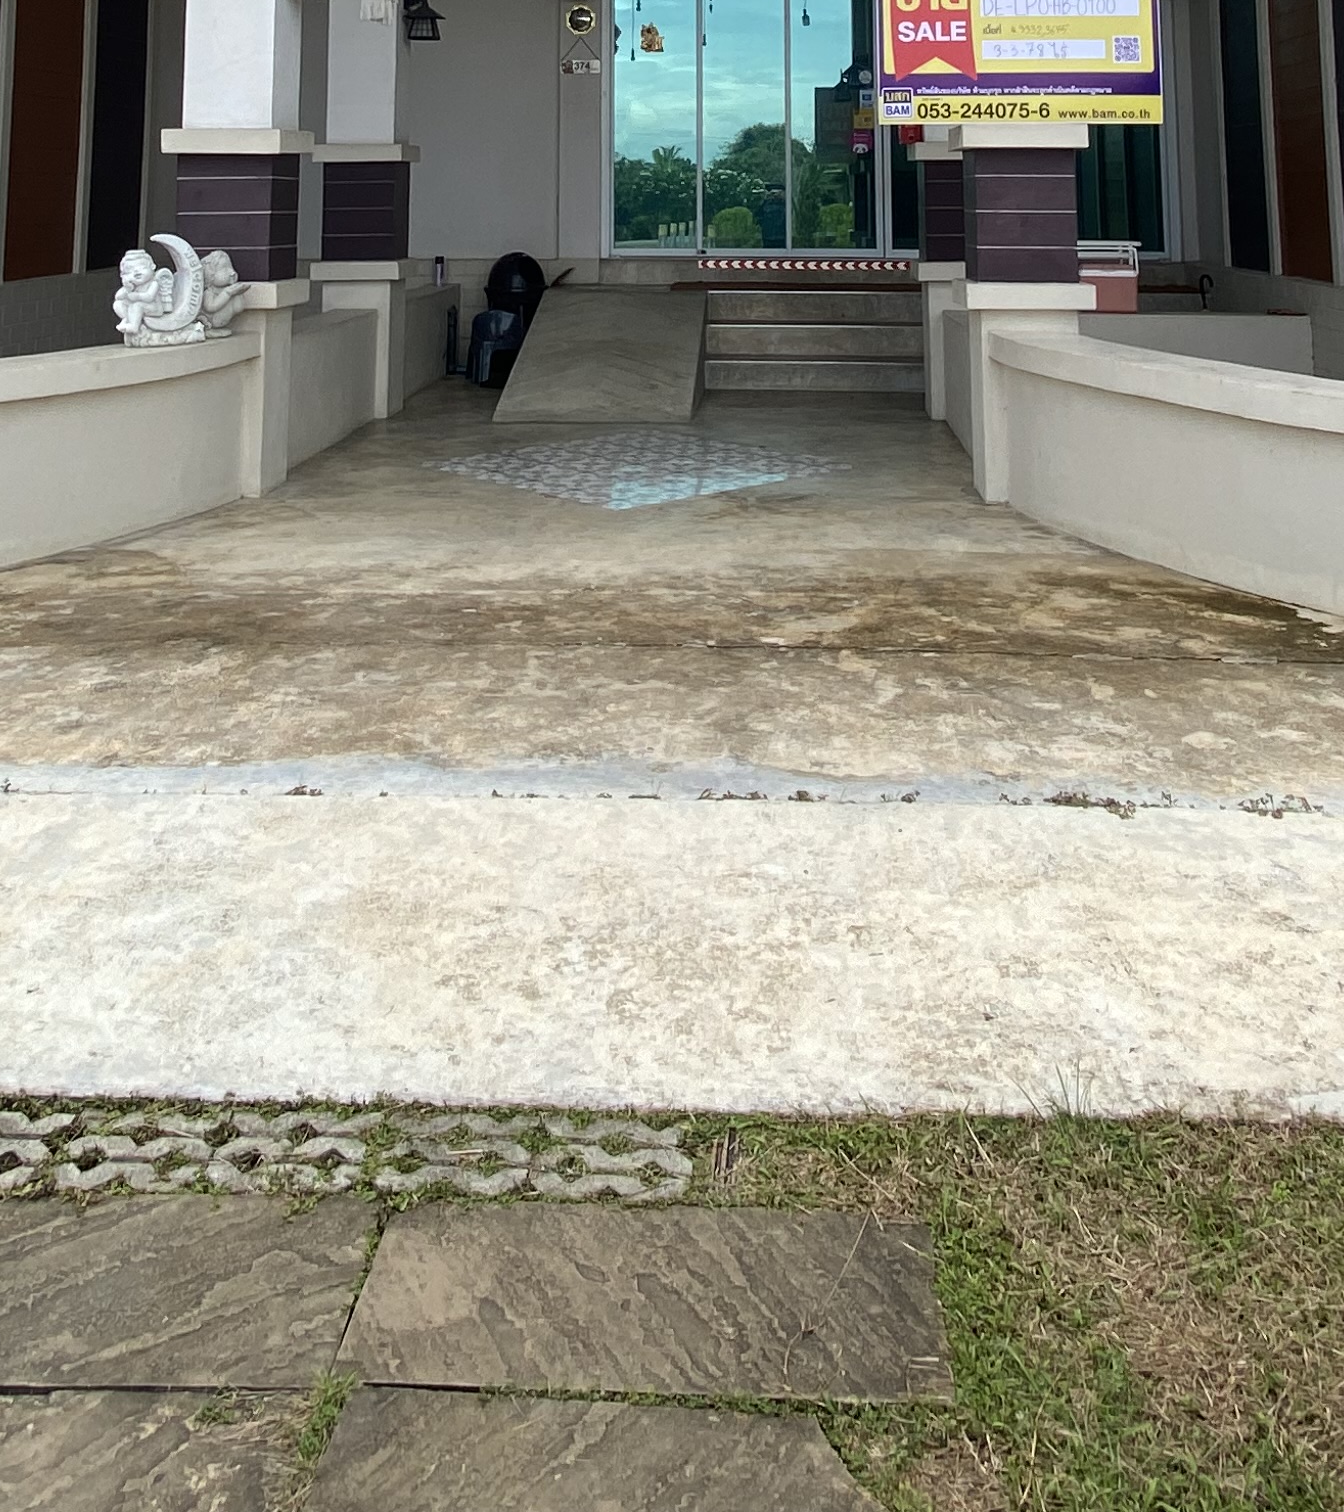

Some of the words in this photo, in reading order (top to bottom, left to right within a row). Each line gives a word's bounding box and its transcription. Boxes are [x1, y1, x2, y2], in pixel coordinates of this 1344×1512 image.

[897, 21, 967, 42] SALE
[885, 91, 910, 102] บสก
[885, 105, 910, 116] BAM
[917, 102, 1051, 119] 053-244075-6
[1058, 108, 1151, 119] www.bam.co.th
